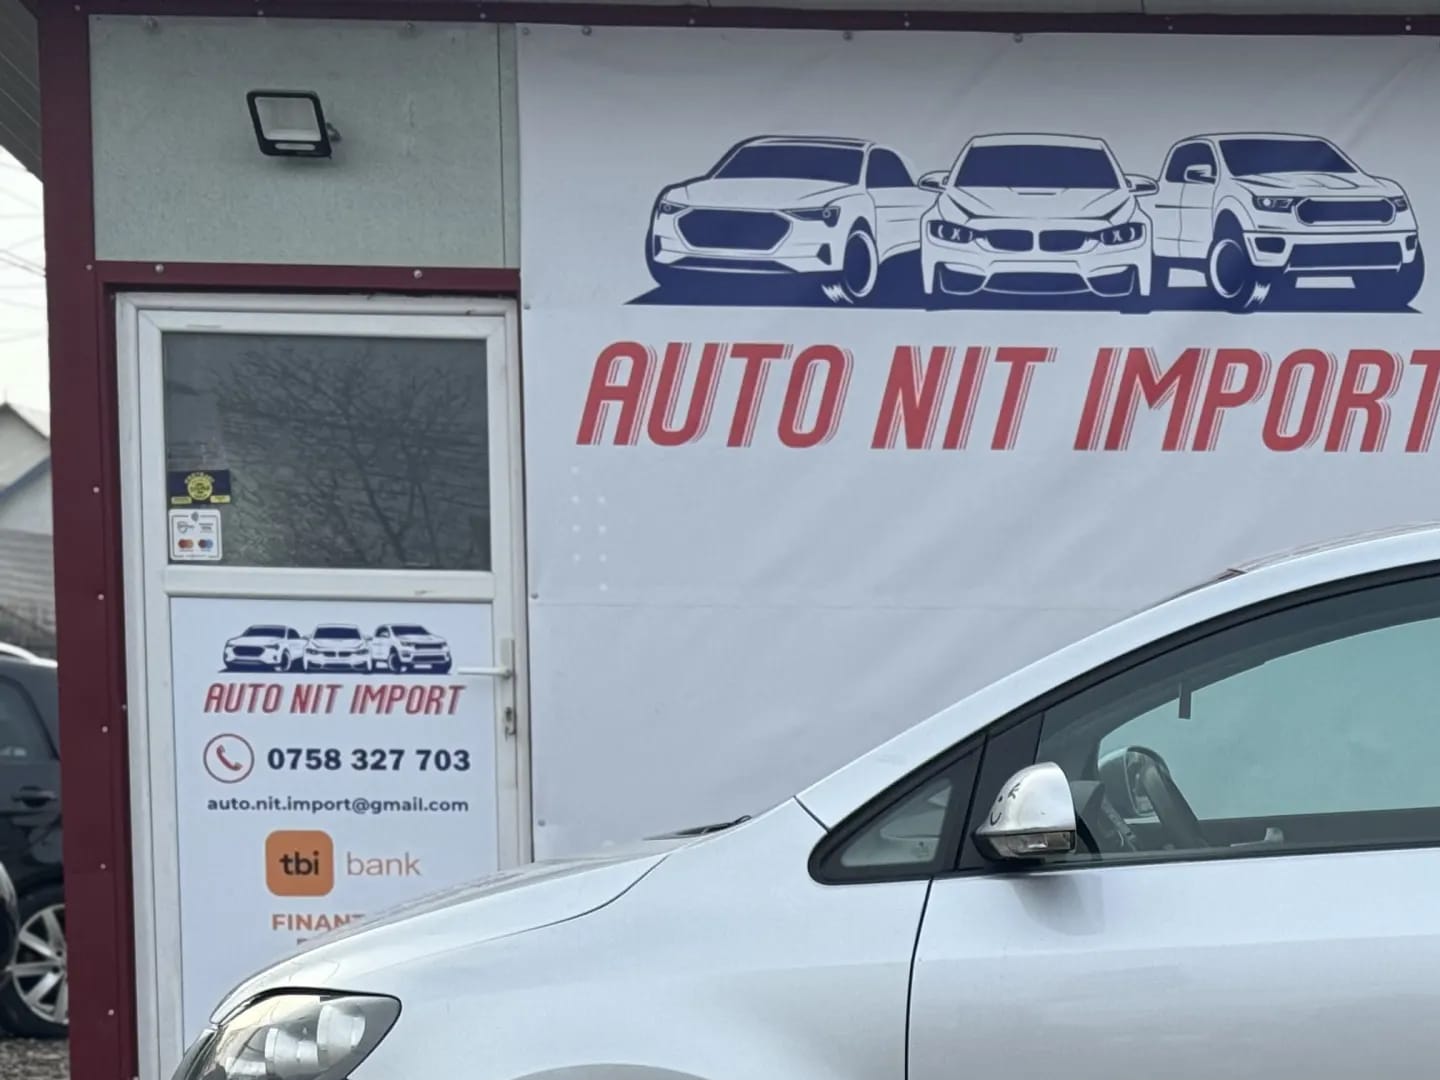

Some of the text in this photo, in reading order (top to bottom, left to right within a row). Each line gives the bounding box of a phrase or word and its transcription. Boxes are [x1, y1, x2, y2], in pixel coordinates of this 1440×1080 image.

[576, 341, 855, 450] AUTO
[870, 345, 1058, 452] NIT
[203, 682, 466, 715] AUTO NIT IMPORT
[267, 748, 471, 772] 0758 327 703
[207, 797, 469, 815] auto.nit.import@gmail.com
[279, 850, 422, 876] tbi bank
[271, 913, 365, 931] FINAN
